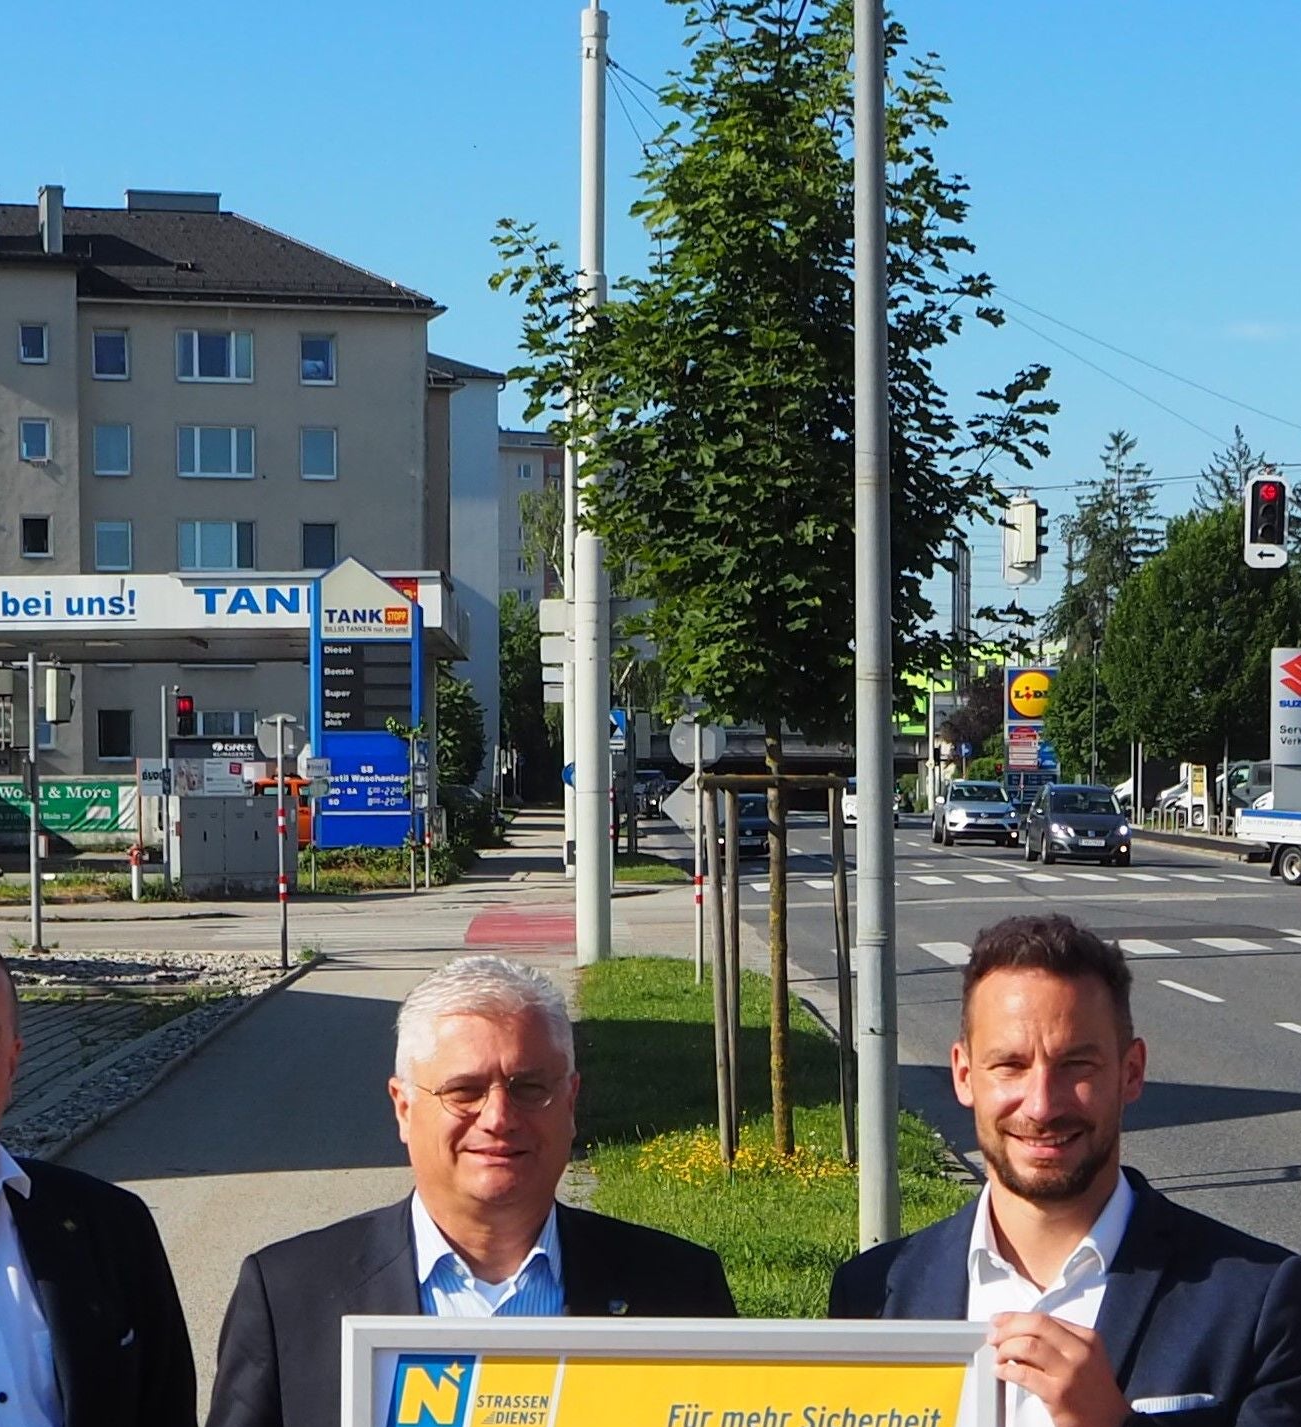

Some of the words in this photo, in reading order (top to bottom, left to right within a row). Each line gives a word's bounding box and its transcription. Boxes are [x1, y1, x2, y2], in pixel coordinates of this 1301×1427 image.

[1, 590, 52, 616] bei
[66, 589, 137, 616] uns!
[193, 587, 312, 615] TAN
[325, 609, 383, 623] TANK
[324, 645, 352, 655] Diesel
[48, 787, 61, 798] &
[66, 786, 111, 798] More
[476, 1395, 549, 1409] STRASSEN
[495, 1411, 547, 1425] DIENST
